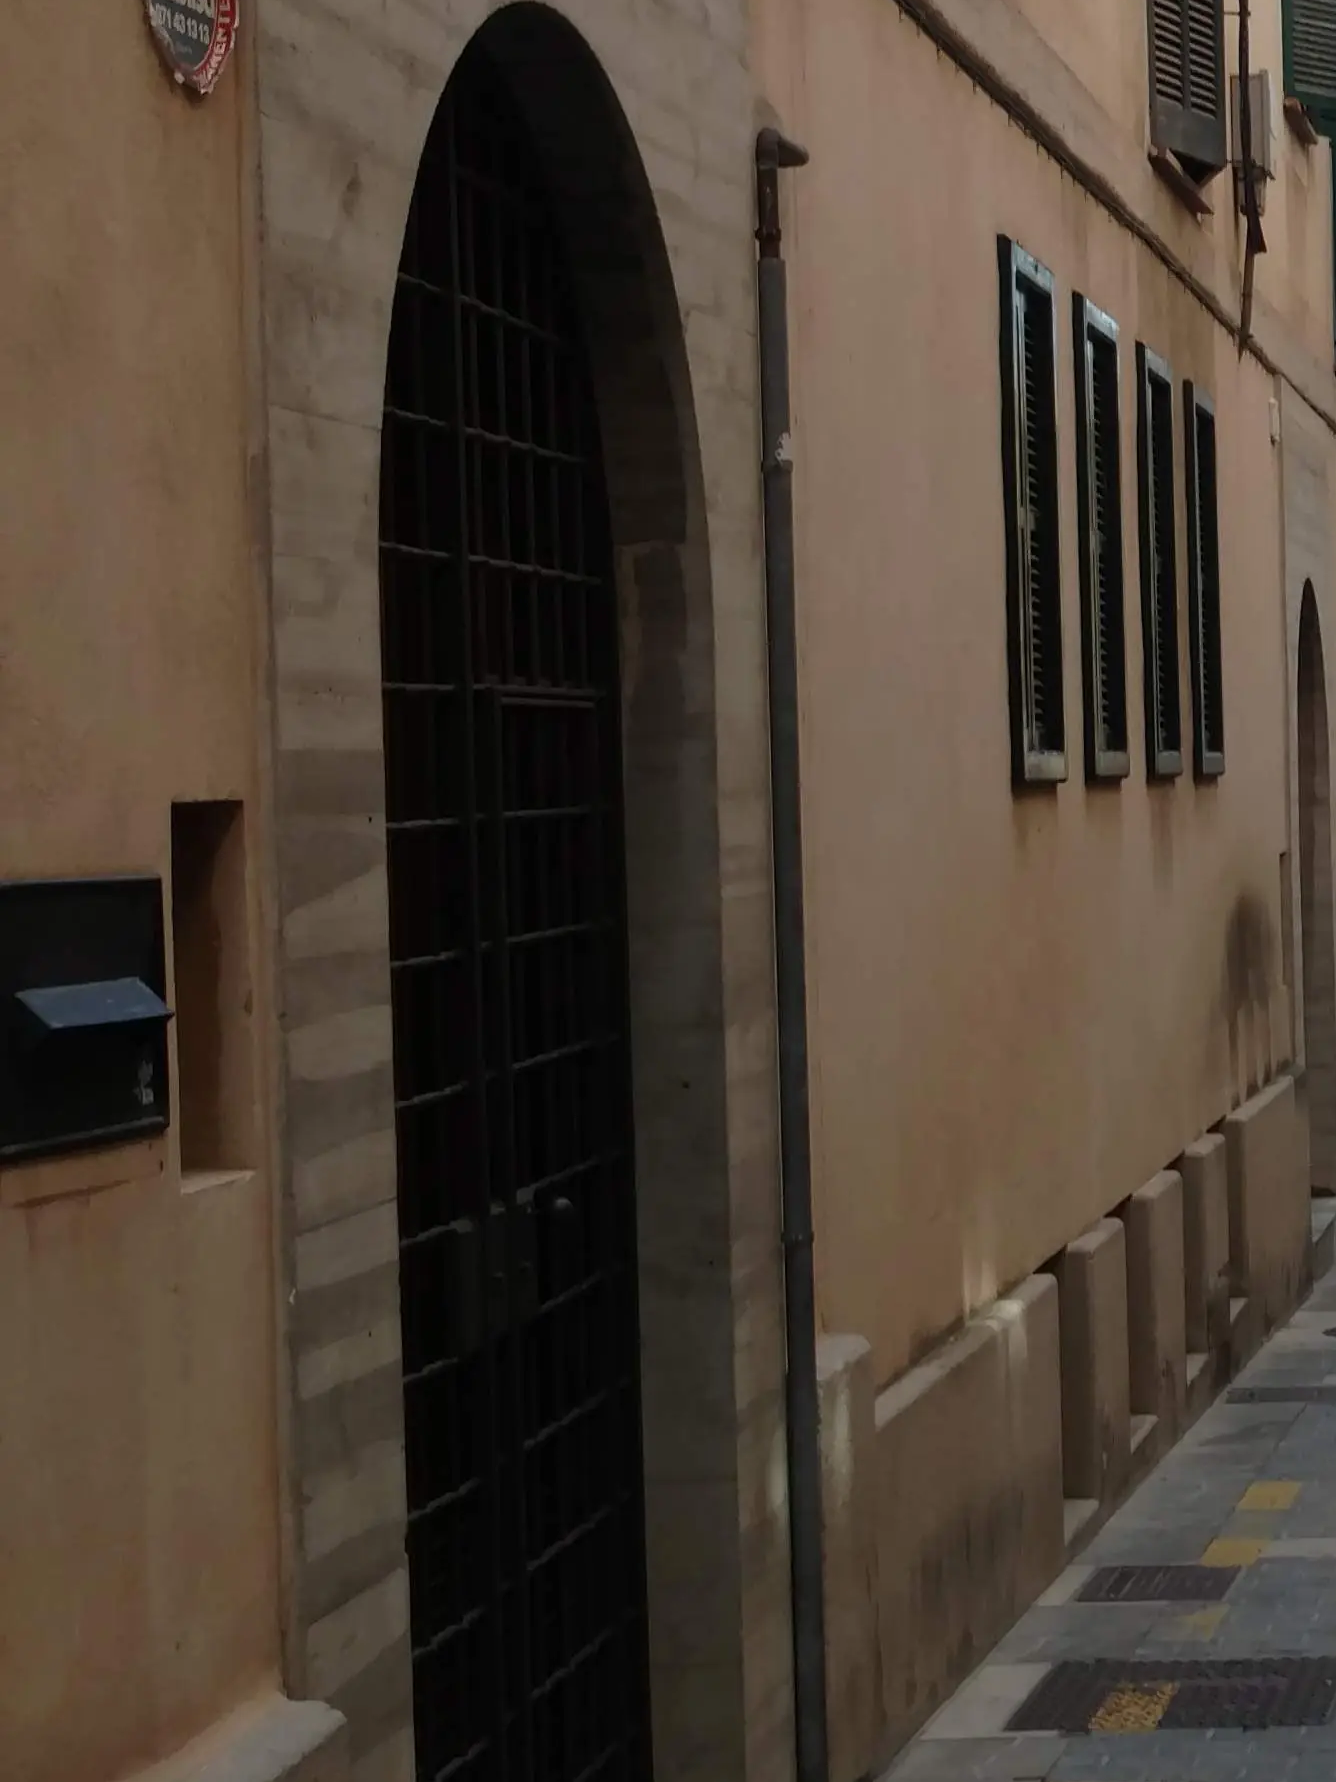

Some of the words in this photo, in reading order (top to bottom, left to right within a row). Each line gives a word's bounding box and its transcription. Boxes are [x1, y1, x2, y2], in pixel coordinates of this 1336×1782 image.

[173, 11, 186, 35] 43
[186, 17, 198, 40] 13
[198, 23, 210, 45] 13
